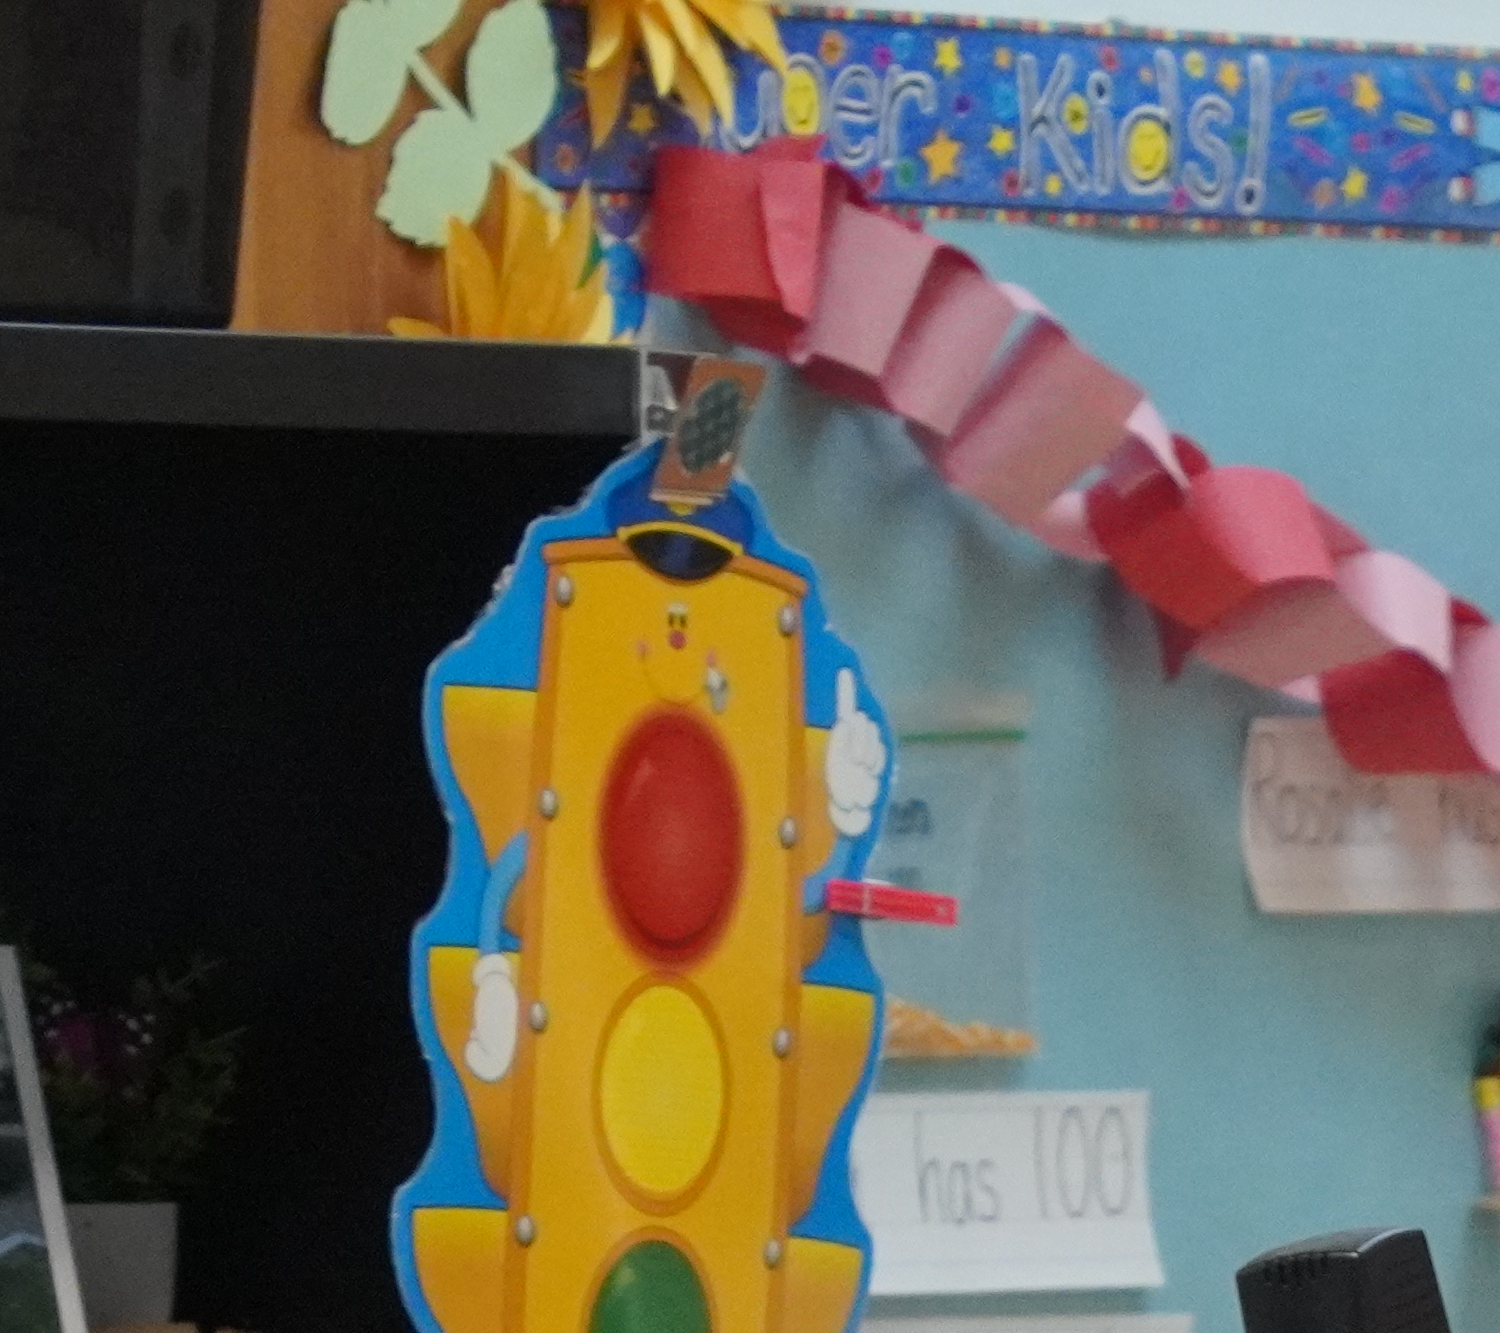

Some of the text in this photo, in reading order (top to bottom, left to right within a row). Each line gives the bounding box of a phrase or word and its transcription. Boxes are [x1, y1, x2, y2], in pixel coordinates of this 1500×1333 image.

[717, 47, 1272, 215] uper Kids!
[912, 1105, 1134, 1226] has 100
